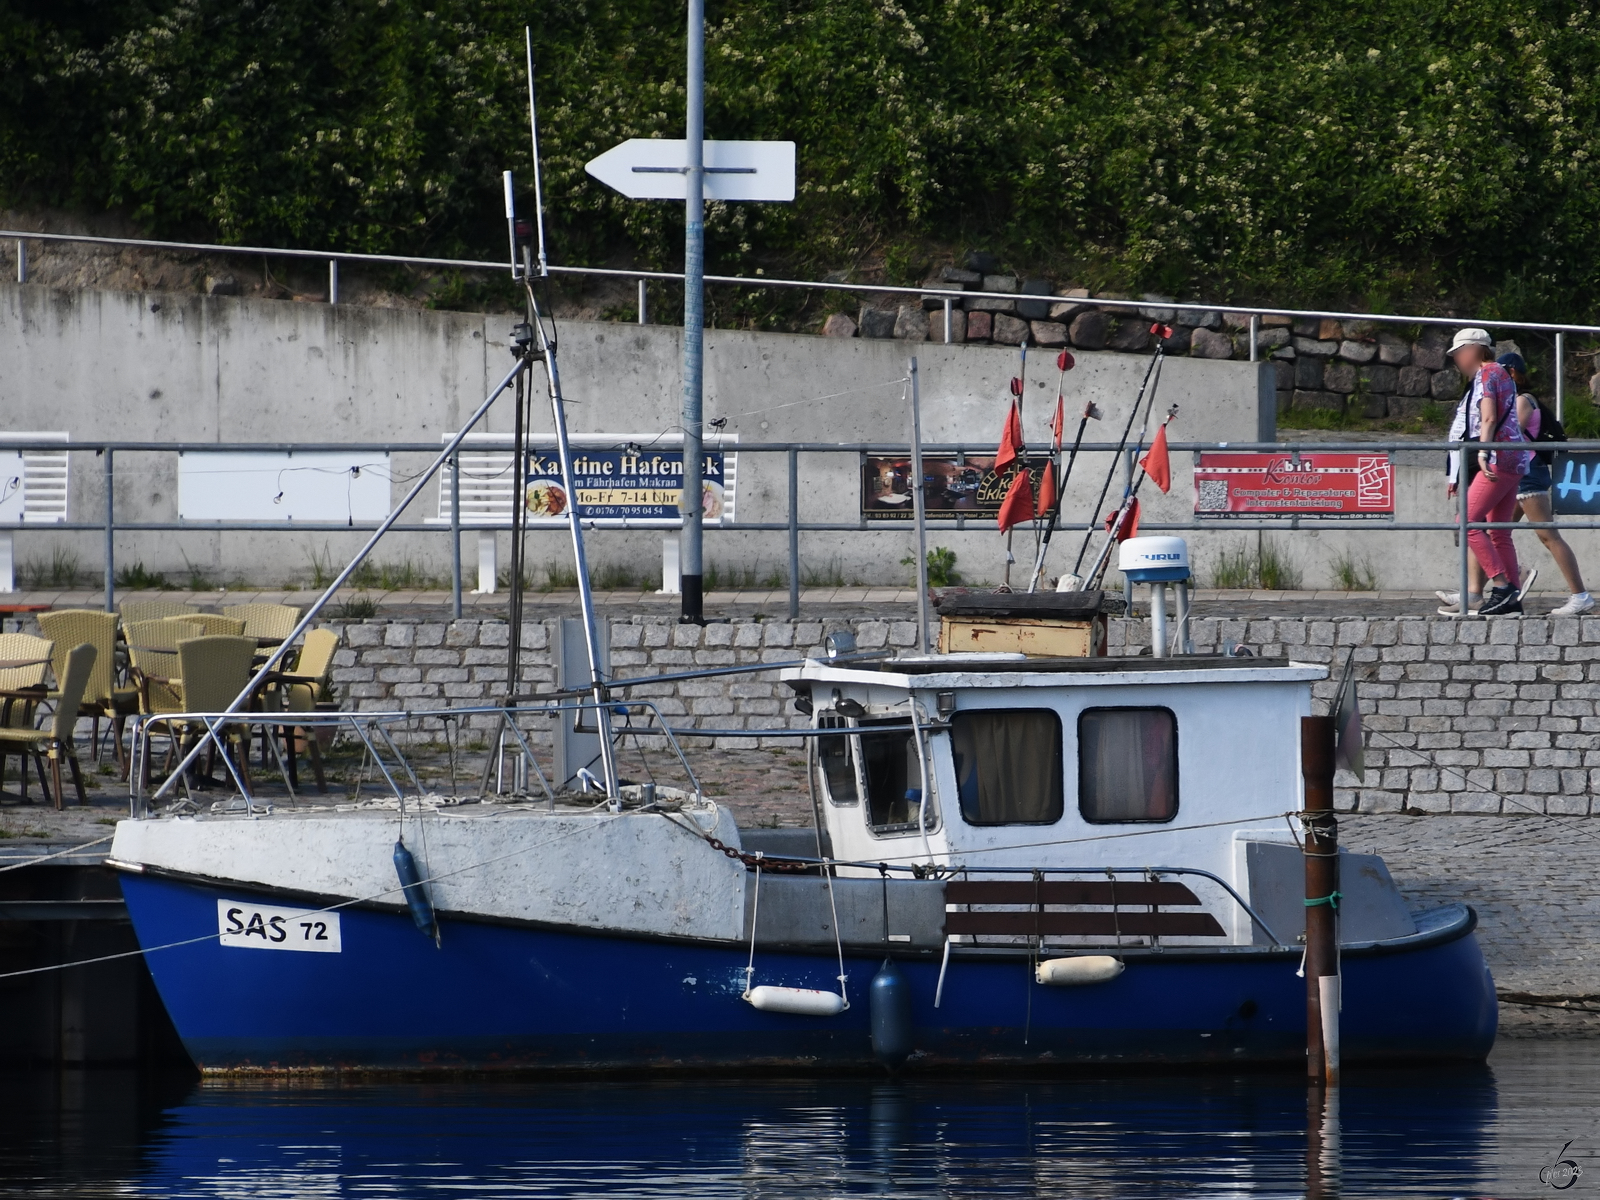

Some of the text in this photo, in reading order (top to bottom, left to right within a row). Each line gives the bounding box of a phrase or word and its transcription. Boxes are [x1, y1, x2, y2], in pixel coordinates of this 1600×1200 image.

[620, 456, 720, 475] Hafenk
[1262, 458, 1322, 484] Kontor
[1284, 460, 1312, 472] bit
[587, 477, 636, 487] Fährhafen
[621, 492, 647, 503] 7-14
[652, 492, 677, 503] Uhr
[1233, 488, 1356, 499] Computer & Reparaturen
[1246, 499, 1344, 509] Internetentwicklung
[595, 506, 614, 515] 0176
[620, 506, 630, 515] 70
[632, 506, 641, 515] 95
[642, 506, 652, 515] 04
[654, 506, 663, 515] 54
[225, 907, 329, 943] SAS 72
